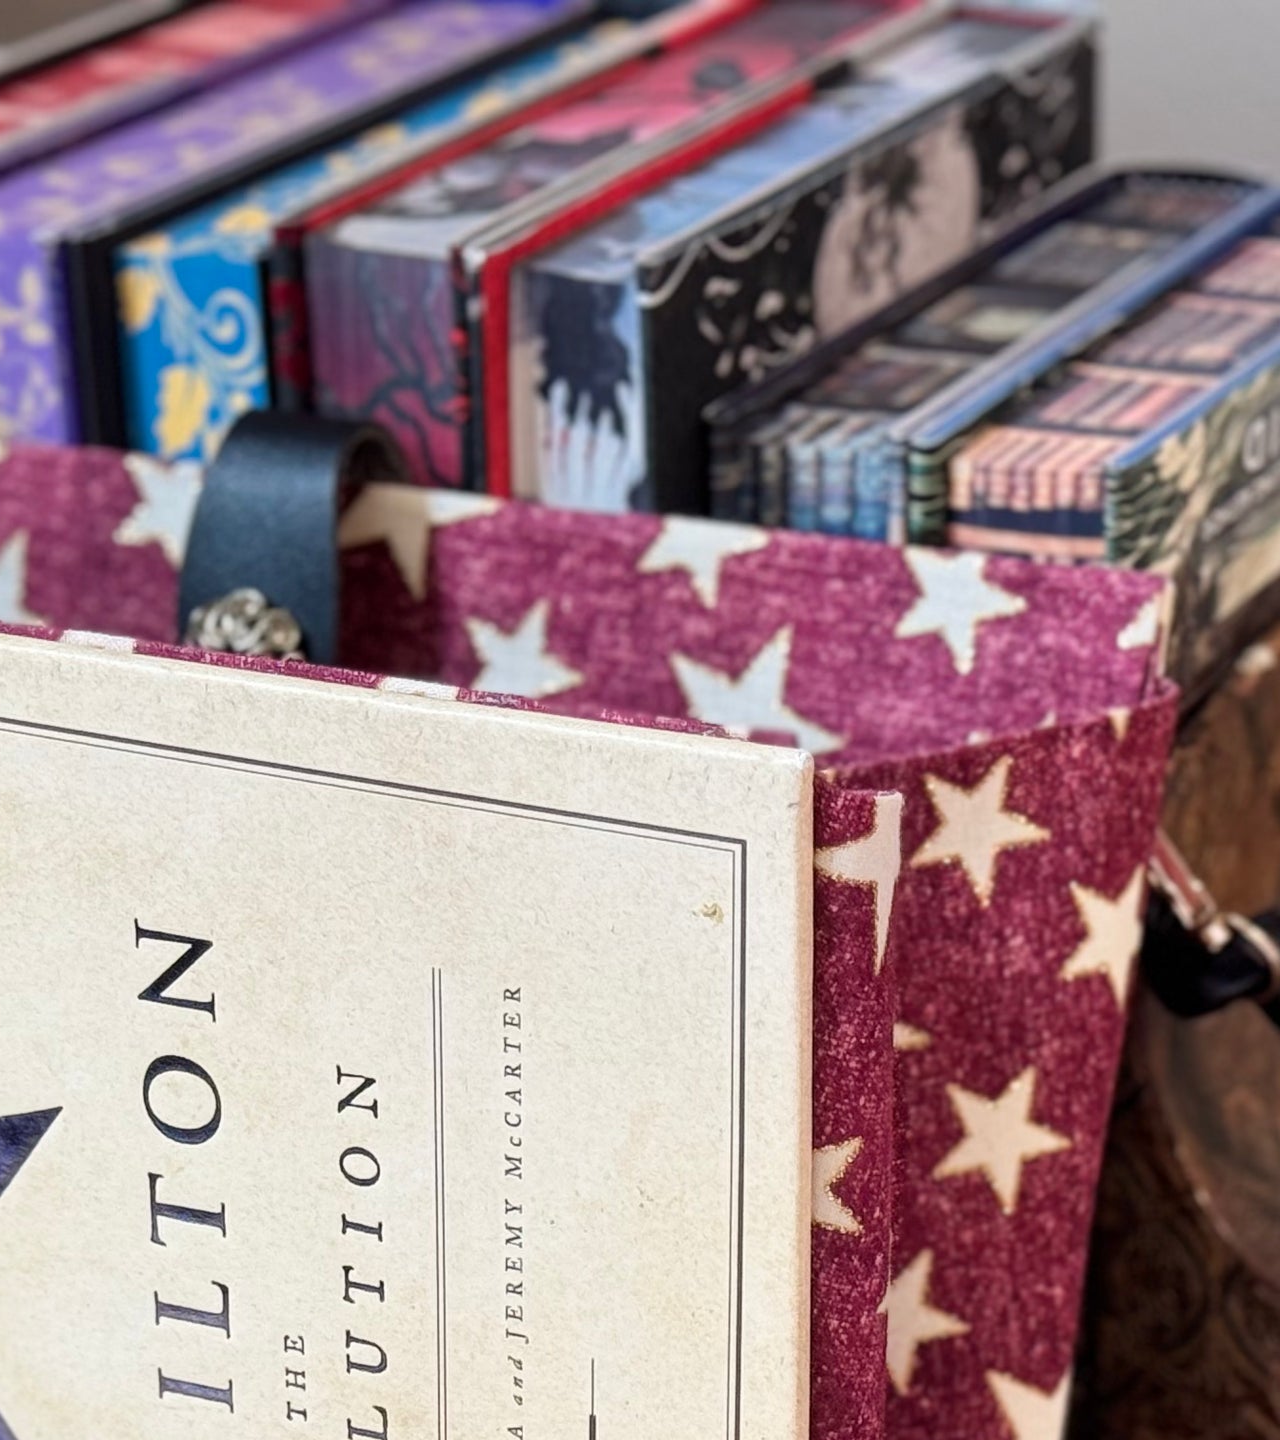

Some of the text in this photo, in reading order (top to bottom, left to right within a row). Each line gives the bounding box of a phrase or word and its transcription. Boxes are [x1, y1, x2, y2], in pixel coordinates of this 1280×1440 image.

[502, 986, 524, 1180] McCARTER
[503, 1197, 530, 1345] JEREMY
[282, 1333, 309, 1423] THE
[506, 1354, 525, 1406] and
